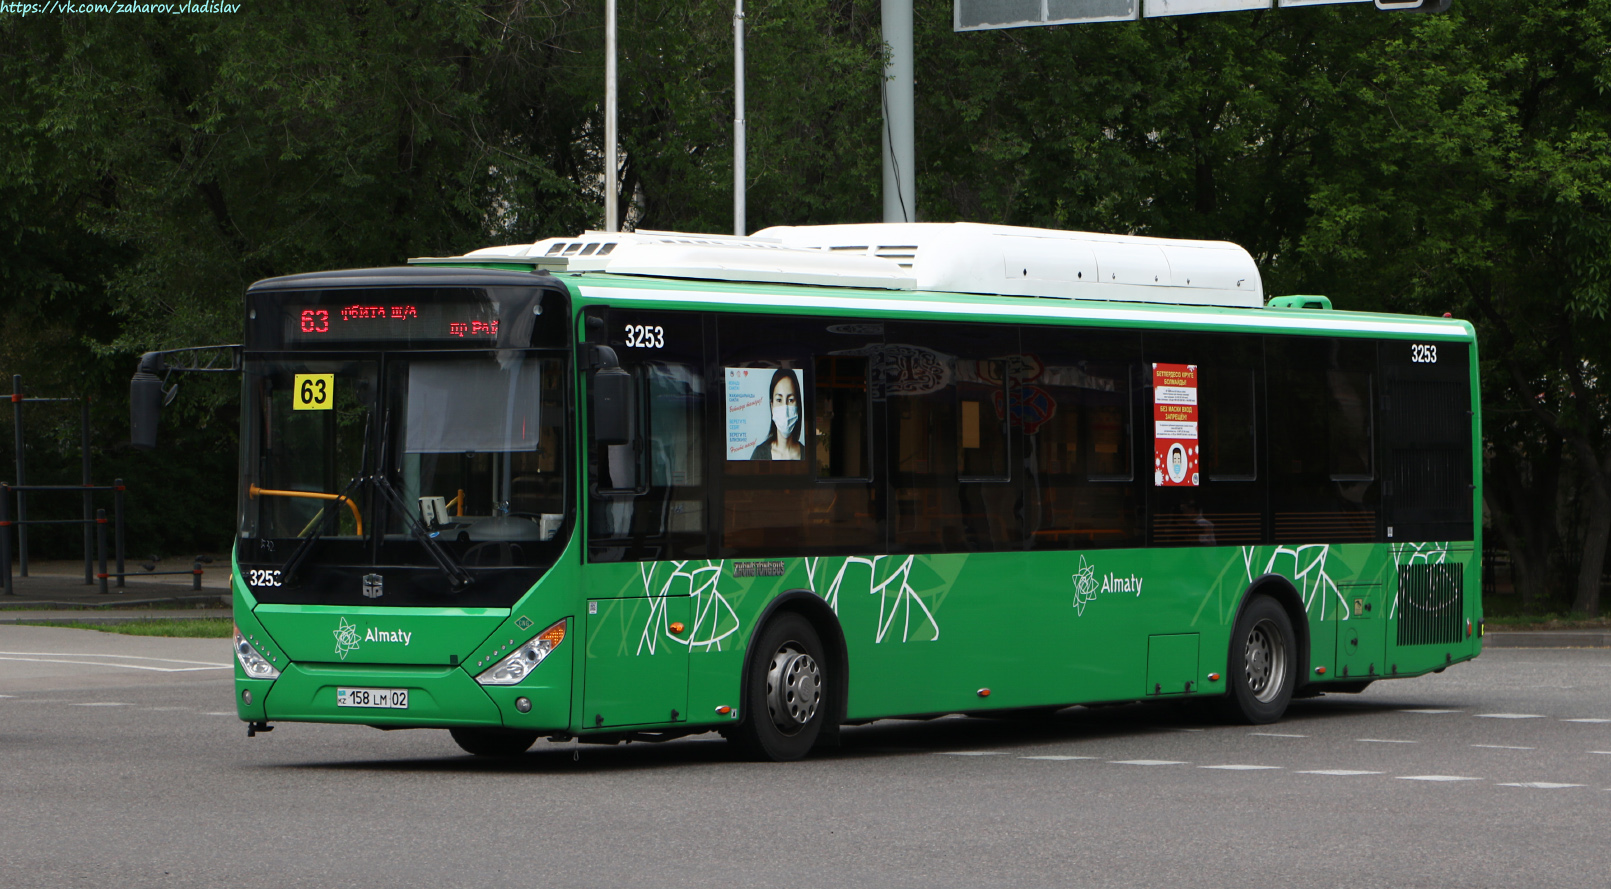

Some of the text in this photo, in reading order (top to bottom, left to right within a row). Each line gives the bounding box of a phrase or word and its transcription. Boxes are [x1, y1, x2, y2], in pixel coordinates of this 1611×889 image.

[301, 310, 329, 332] 63
[625, 324, 664, 349] 3253
[1411, 343, 1437, 363] 3253
[301, 379, 326, 404] 63
[250, 569, 282, 587] 3253
[1101, 571, 1143, 597] Almaty
[365, 627, 412, 646] Almaty
[349, 690, 406, 706] 158 LM 02
